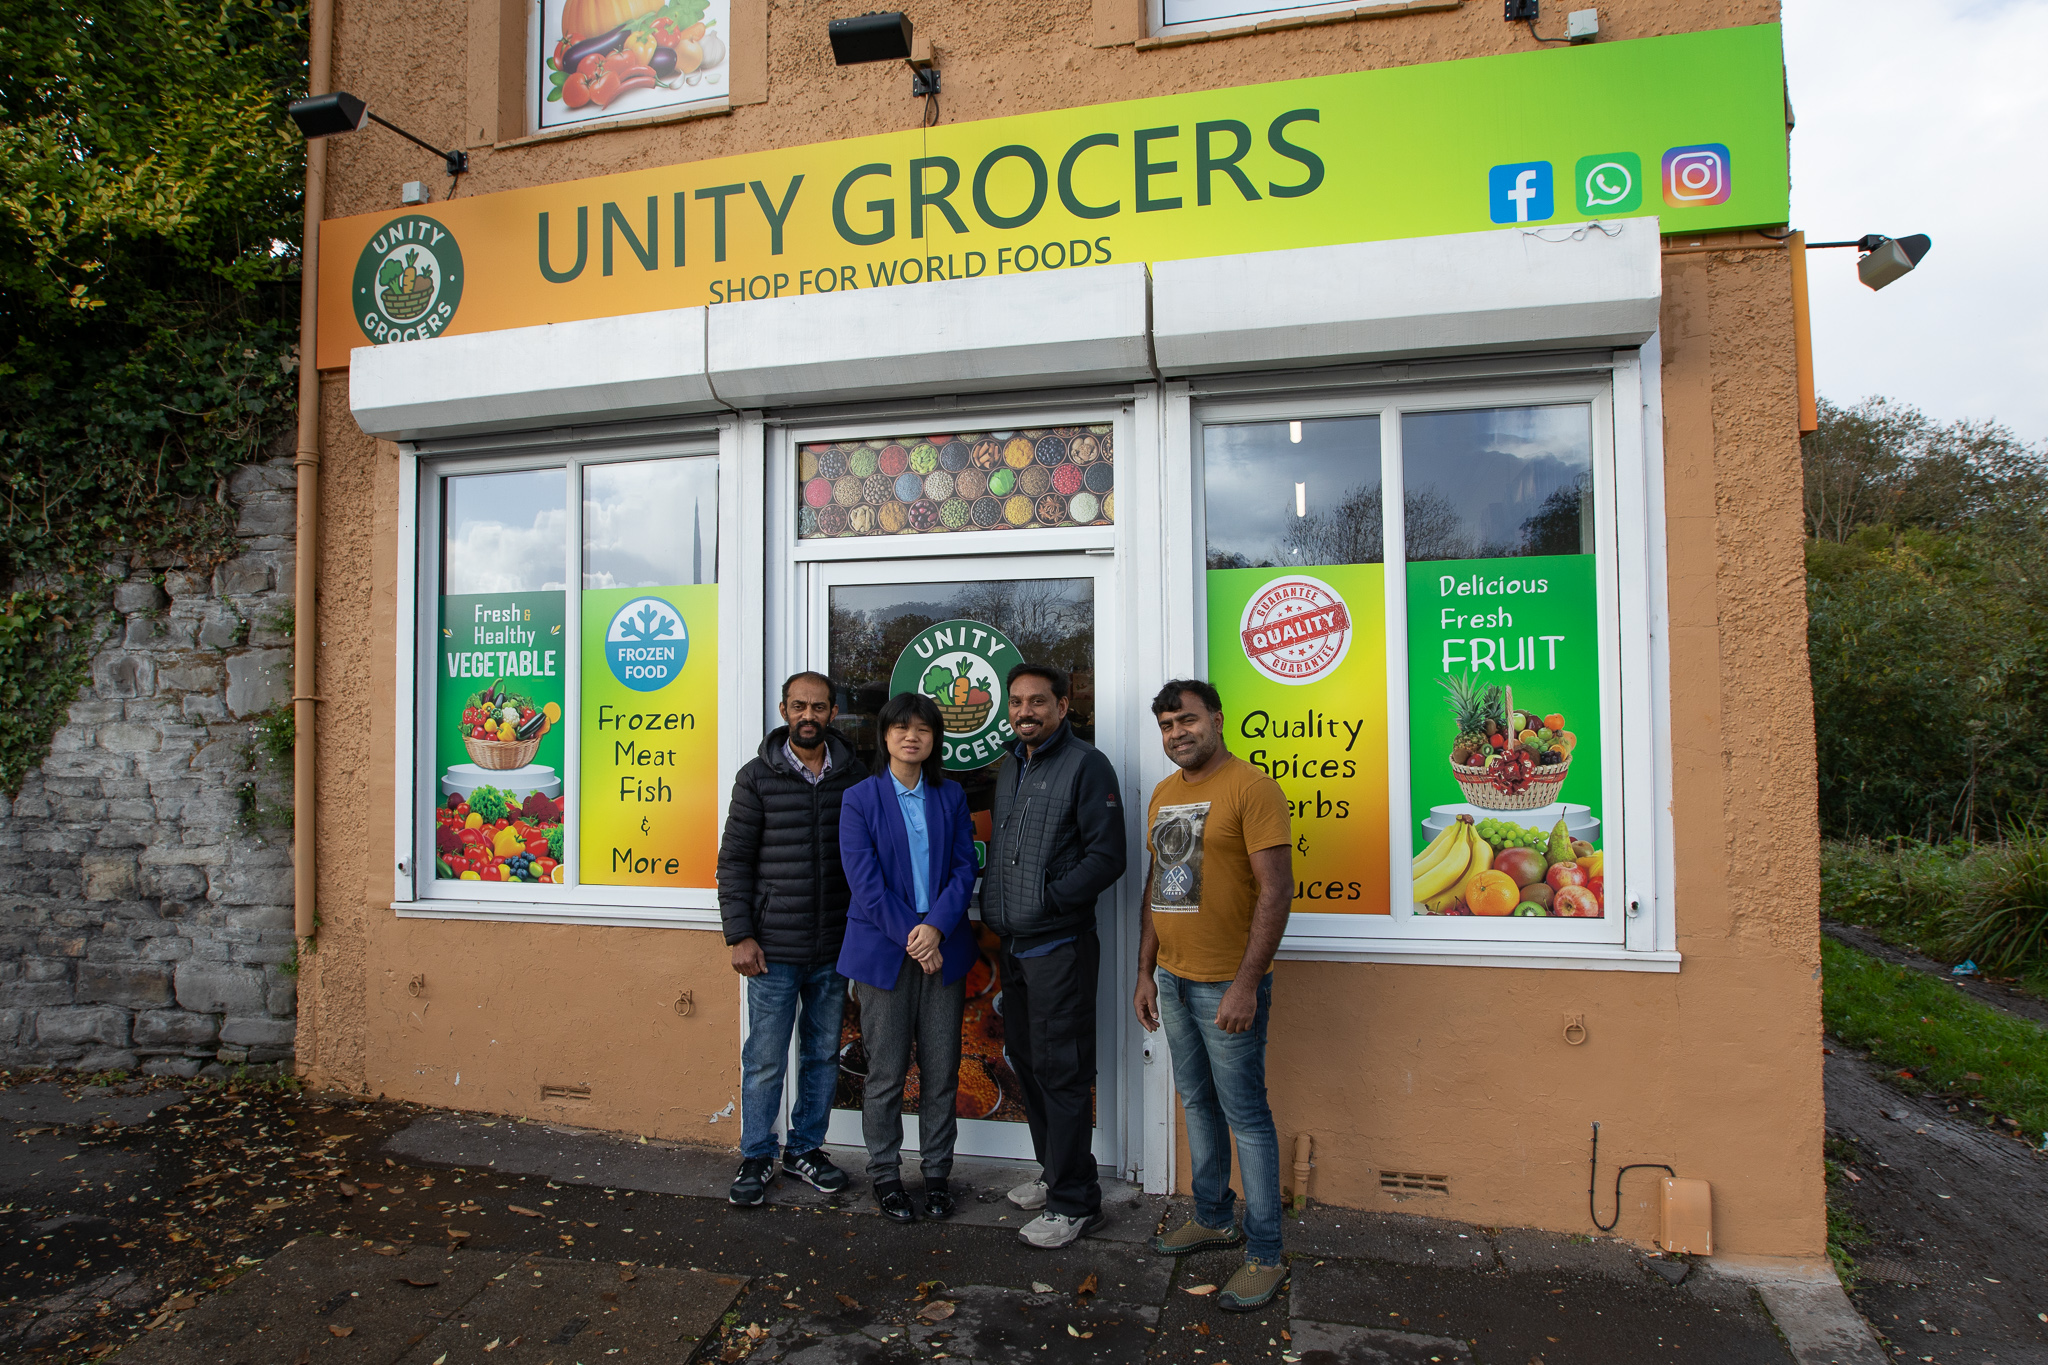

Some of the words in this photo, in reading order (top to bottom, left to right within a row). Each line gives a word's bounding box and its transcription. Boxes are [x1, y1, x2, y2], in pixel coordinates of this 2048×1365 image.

[538, 174, 804, 284] UNITY
[831, 108, 1325, 246] GROCERS
[372, 221, 445, 254] UNITY
[709, 272, 789, 305] SHOP
[799, 264, 859, 296] FOR
[867, 251, 987, 287] WORLD
[998, 237, 1112, 272] FOODS
[364, 301, 452, 344] GROCERS
[1439, 574, 1548, 597] Delicious
[475, 602, 521, 623] Fresh
[524, 609, 531, 621] &
[1256, 587, 1318, 617] GUARANTEE
[1252, 611, 1336, 649] QUALITY
[1441, 606, 1513, 629] Fresh
[474, 625, 536, 648] Healthy
[914, 626, 1006, 659] UNITY
[447, 650, 557, 678] VEGETABLE
[618, 646, 675, 661] FROZEN
[1272, 644, 1335, 673] GUARANTEE
[1442, 635, 1565, 673] FRUIT
[625, 665, 668, 679] FOOD
[598, 705, 695, 731] Frozen
[1241, 709, 1363, 752] Quality
[615, 740, 677, 766] Meat
[942, 718, 1014, 763] OCERS
[1249, 750, 1357, 779] Spices
[620, 776, 672, 802] Fish
[1286, 789, 1350, 819] erbs
[640, 816, 651, 836] &
[1297, 834, 1310, 857] &
[612, 847, 680, 875] More
